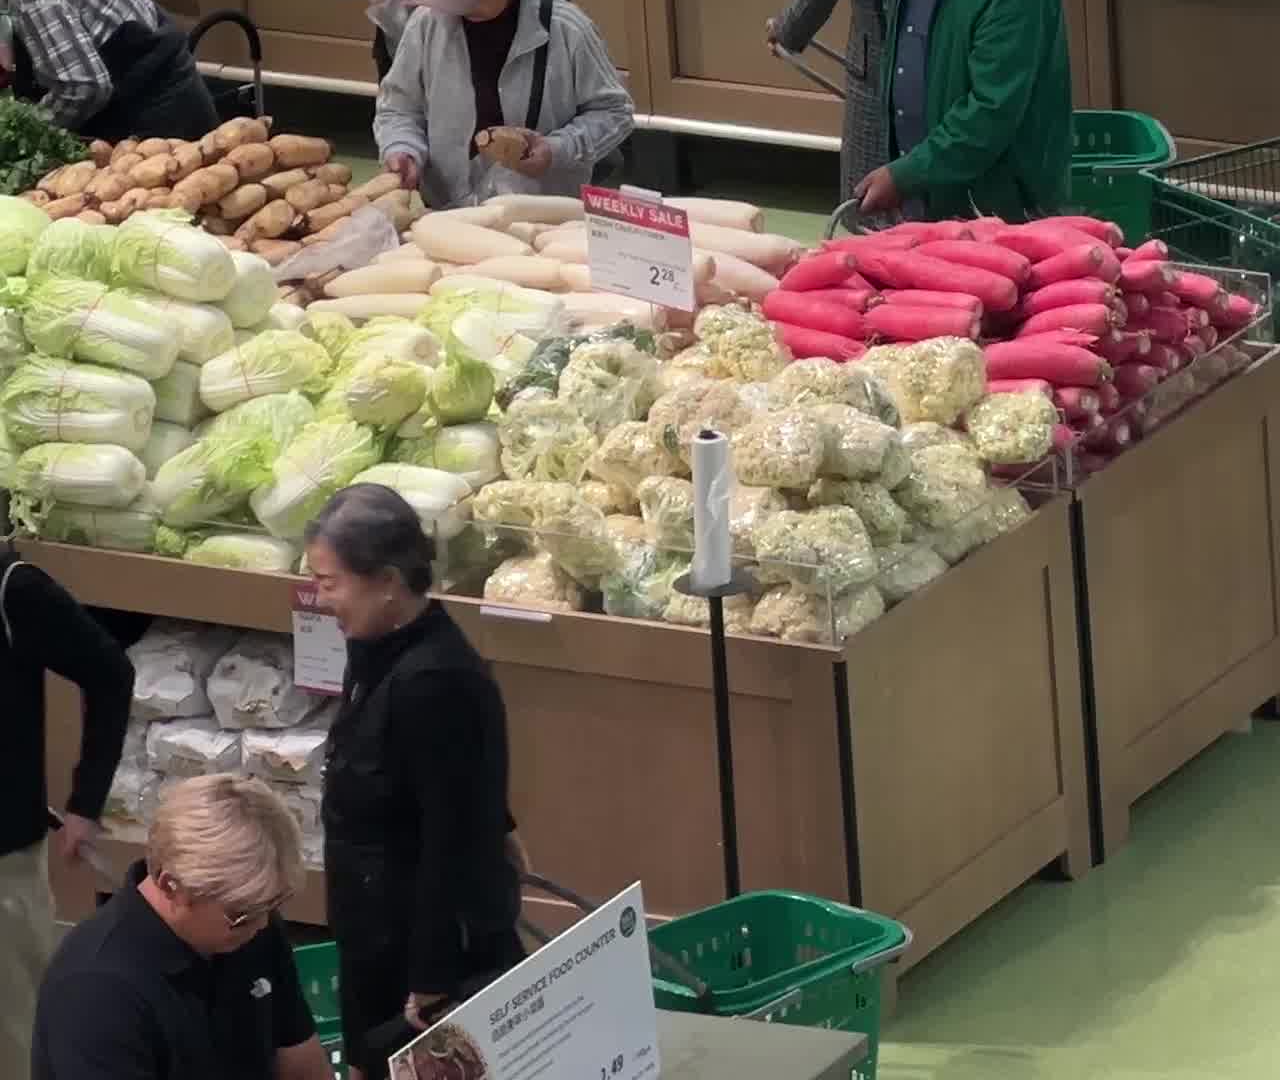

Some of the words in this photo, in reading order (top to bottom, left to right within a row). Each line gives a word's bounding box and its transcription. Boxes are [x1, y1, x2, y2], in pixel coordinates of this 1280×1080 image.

[586, 192, 645, 219] WEEKLY
[648, 207, 685, 229] SALE
[548, 958, 574, 985] FOOD
[574, 928, 617, 965] COUNTER
